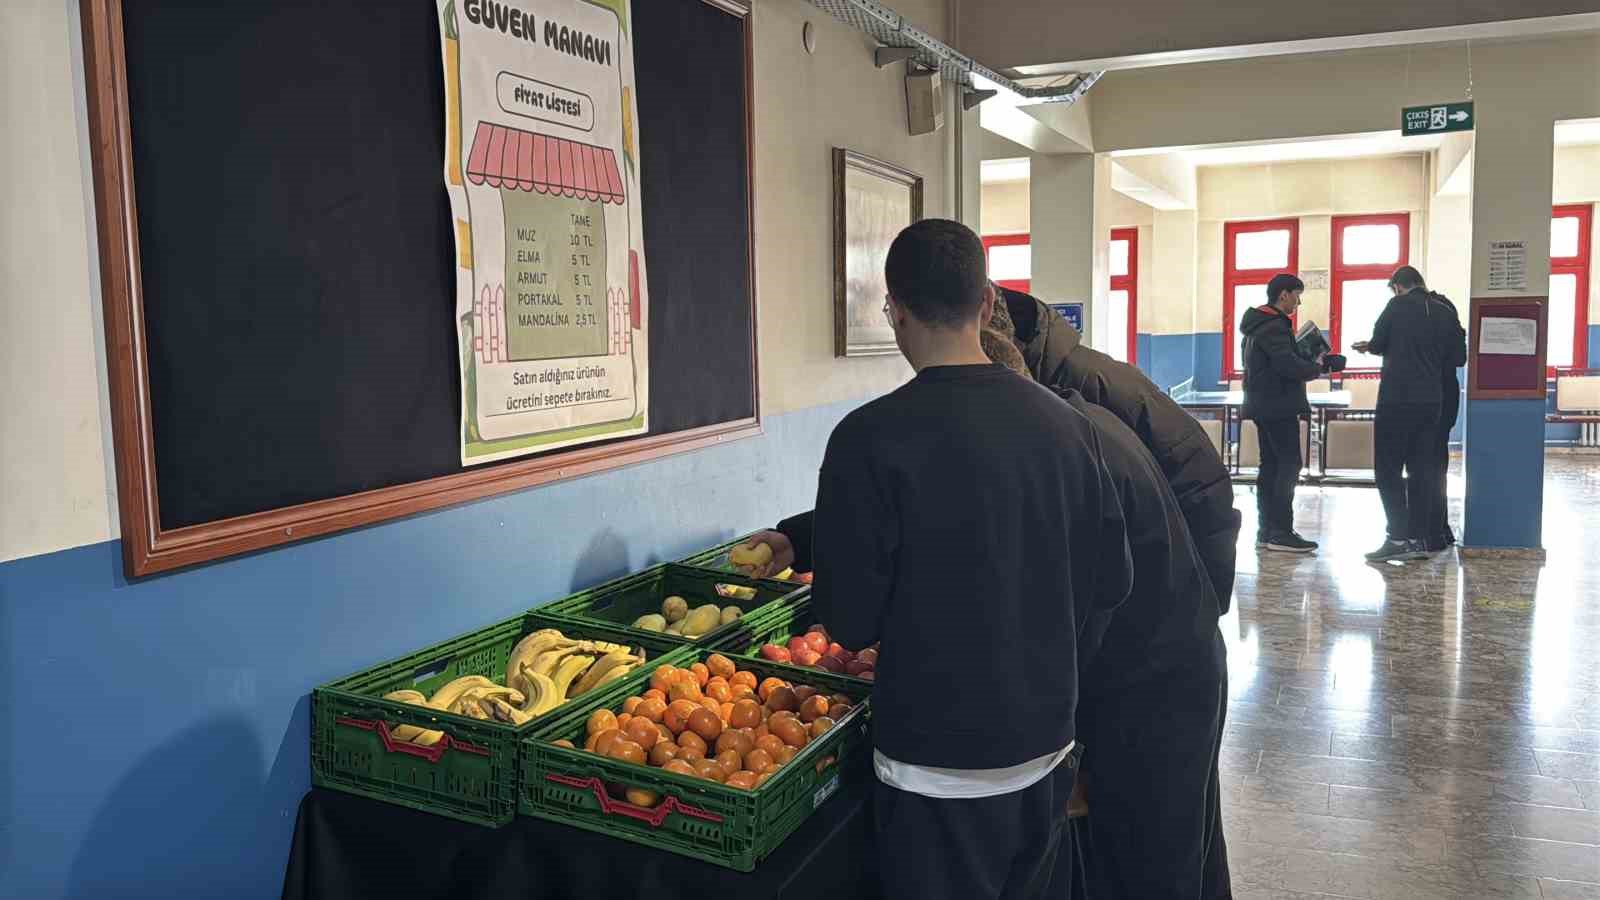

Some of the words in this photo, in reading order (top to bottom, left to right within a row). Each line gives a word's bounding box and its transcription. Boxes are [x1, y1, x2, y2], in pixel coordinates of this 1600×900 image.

[544, 20, 611, 66] MANAVI
[515, 84, 544, 108] FİYAT
[546, 92, 580, 117] LİSTESİ
[1408, 120, 1428, 129] EXIT
[569, 213, 591, 227] TANE
[517, 228, 536, 242] MUZ
[570, 234, 580, 246] 10
[582, 234, 593, 247] TL
[517, 249, 541, 263] ELMA
[571, 254, 577, 266] 5
[579, 254, 591, 267] TL
[517, 271, 547, 285] ARMUT
[574, 273, 580, 286] 5
[582, 274, 592, 287] TL
[517, 293, 564, 306] PORTAKAL
[575, 294, 581, 306] 5
[583, 294, 593, 306] TL
[518, 312, 569, 327] MANDALİNA
[513, 371, 537, 386] Satın
[539, 367, 575, 385] aldığınız
[576, 365, 606, 380] ürünün
[506, 392, 543, 410] ücretini
[544, 391, 574, 408] sepete
